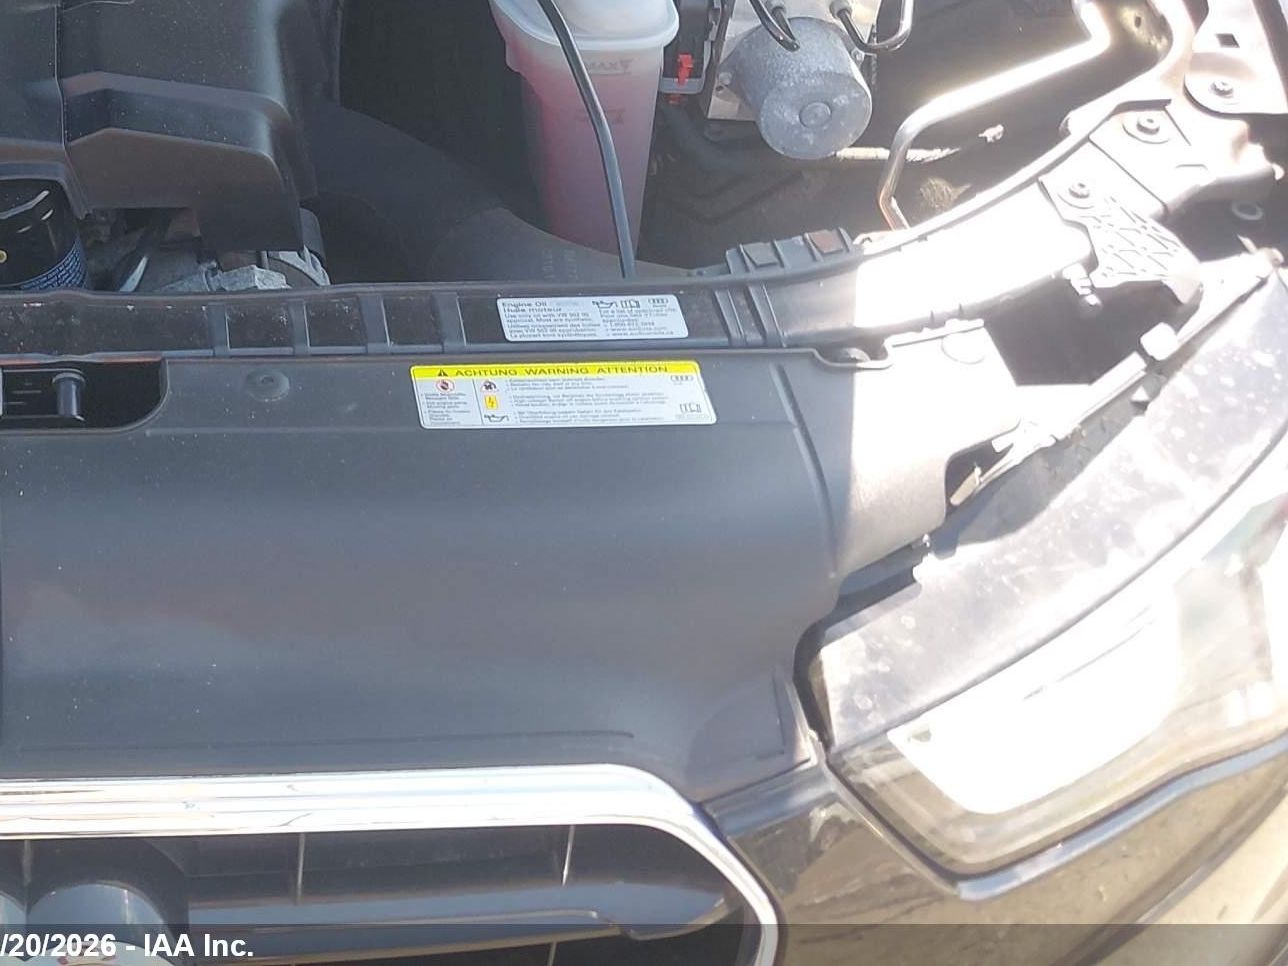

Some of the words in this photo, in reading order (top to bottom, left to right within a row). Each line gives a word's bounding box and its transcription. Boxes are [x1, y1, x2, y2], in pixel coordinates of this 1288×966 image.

[456, 369, 517, 377] ACHTUNG
[524, 367, 589, 375] WARNING
[597, 365, 668, 374] ATTENTION
